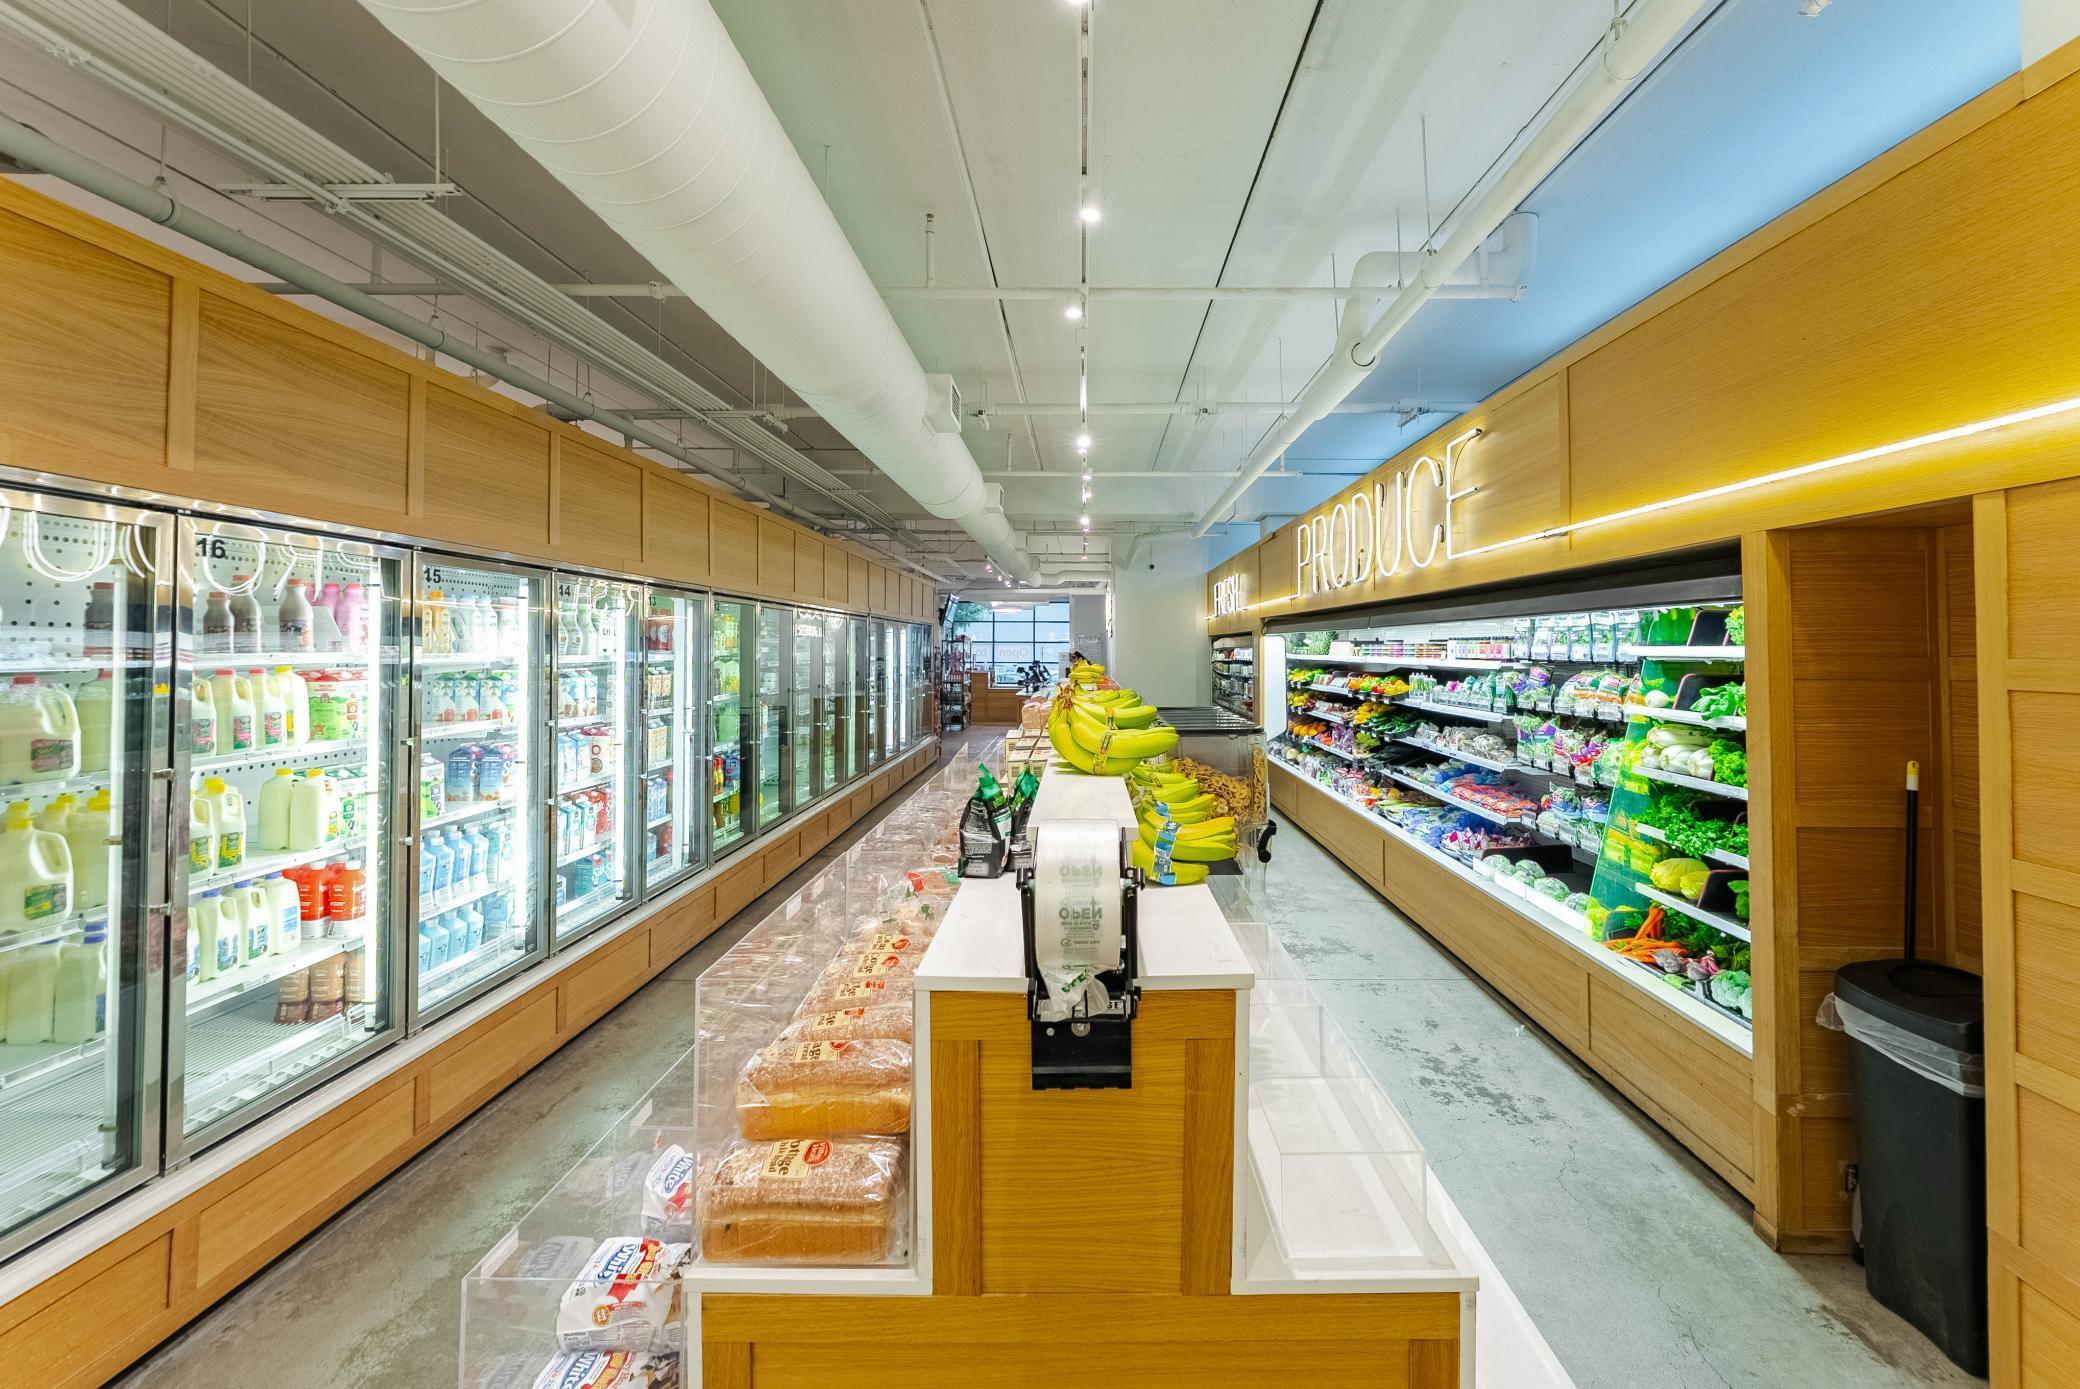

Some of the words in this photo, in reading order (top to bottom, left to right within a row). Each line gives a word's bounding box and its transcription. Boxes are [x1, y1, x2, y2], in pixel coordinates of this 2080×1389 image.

[1213, 573, 1241, 617] FRESH
[1296, 427, 1483, 600] PRODUCE
[196, 537, 226, 559] 16
[423, 567, 442, 584] 15
[558, 584, 571, 597] 14
[649, 595, 657, 607] 13
[779, 1139, 802, 1176] ottage
[665, 1155, 693, 1191] White
[562, 1352, 598, 1389] White
